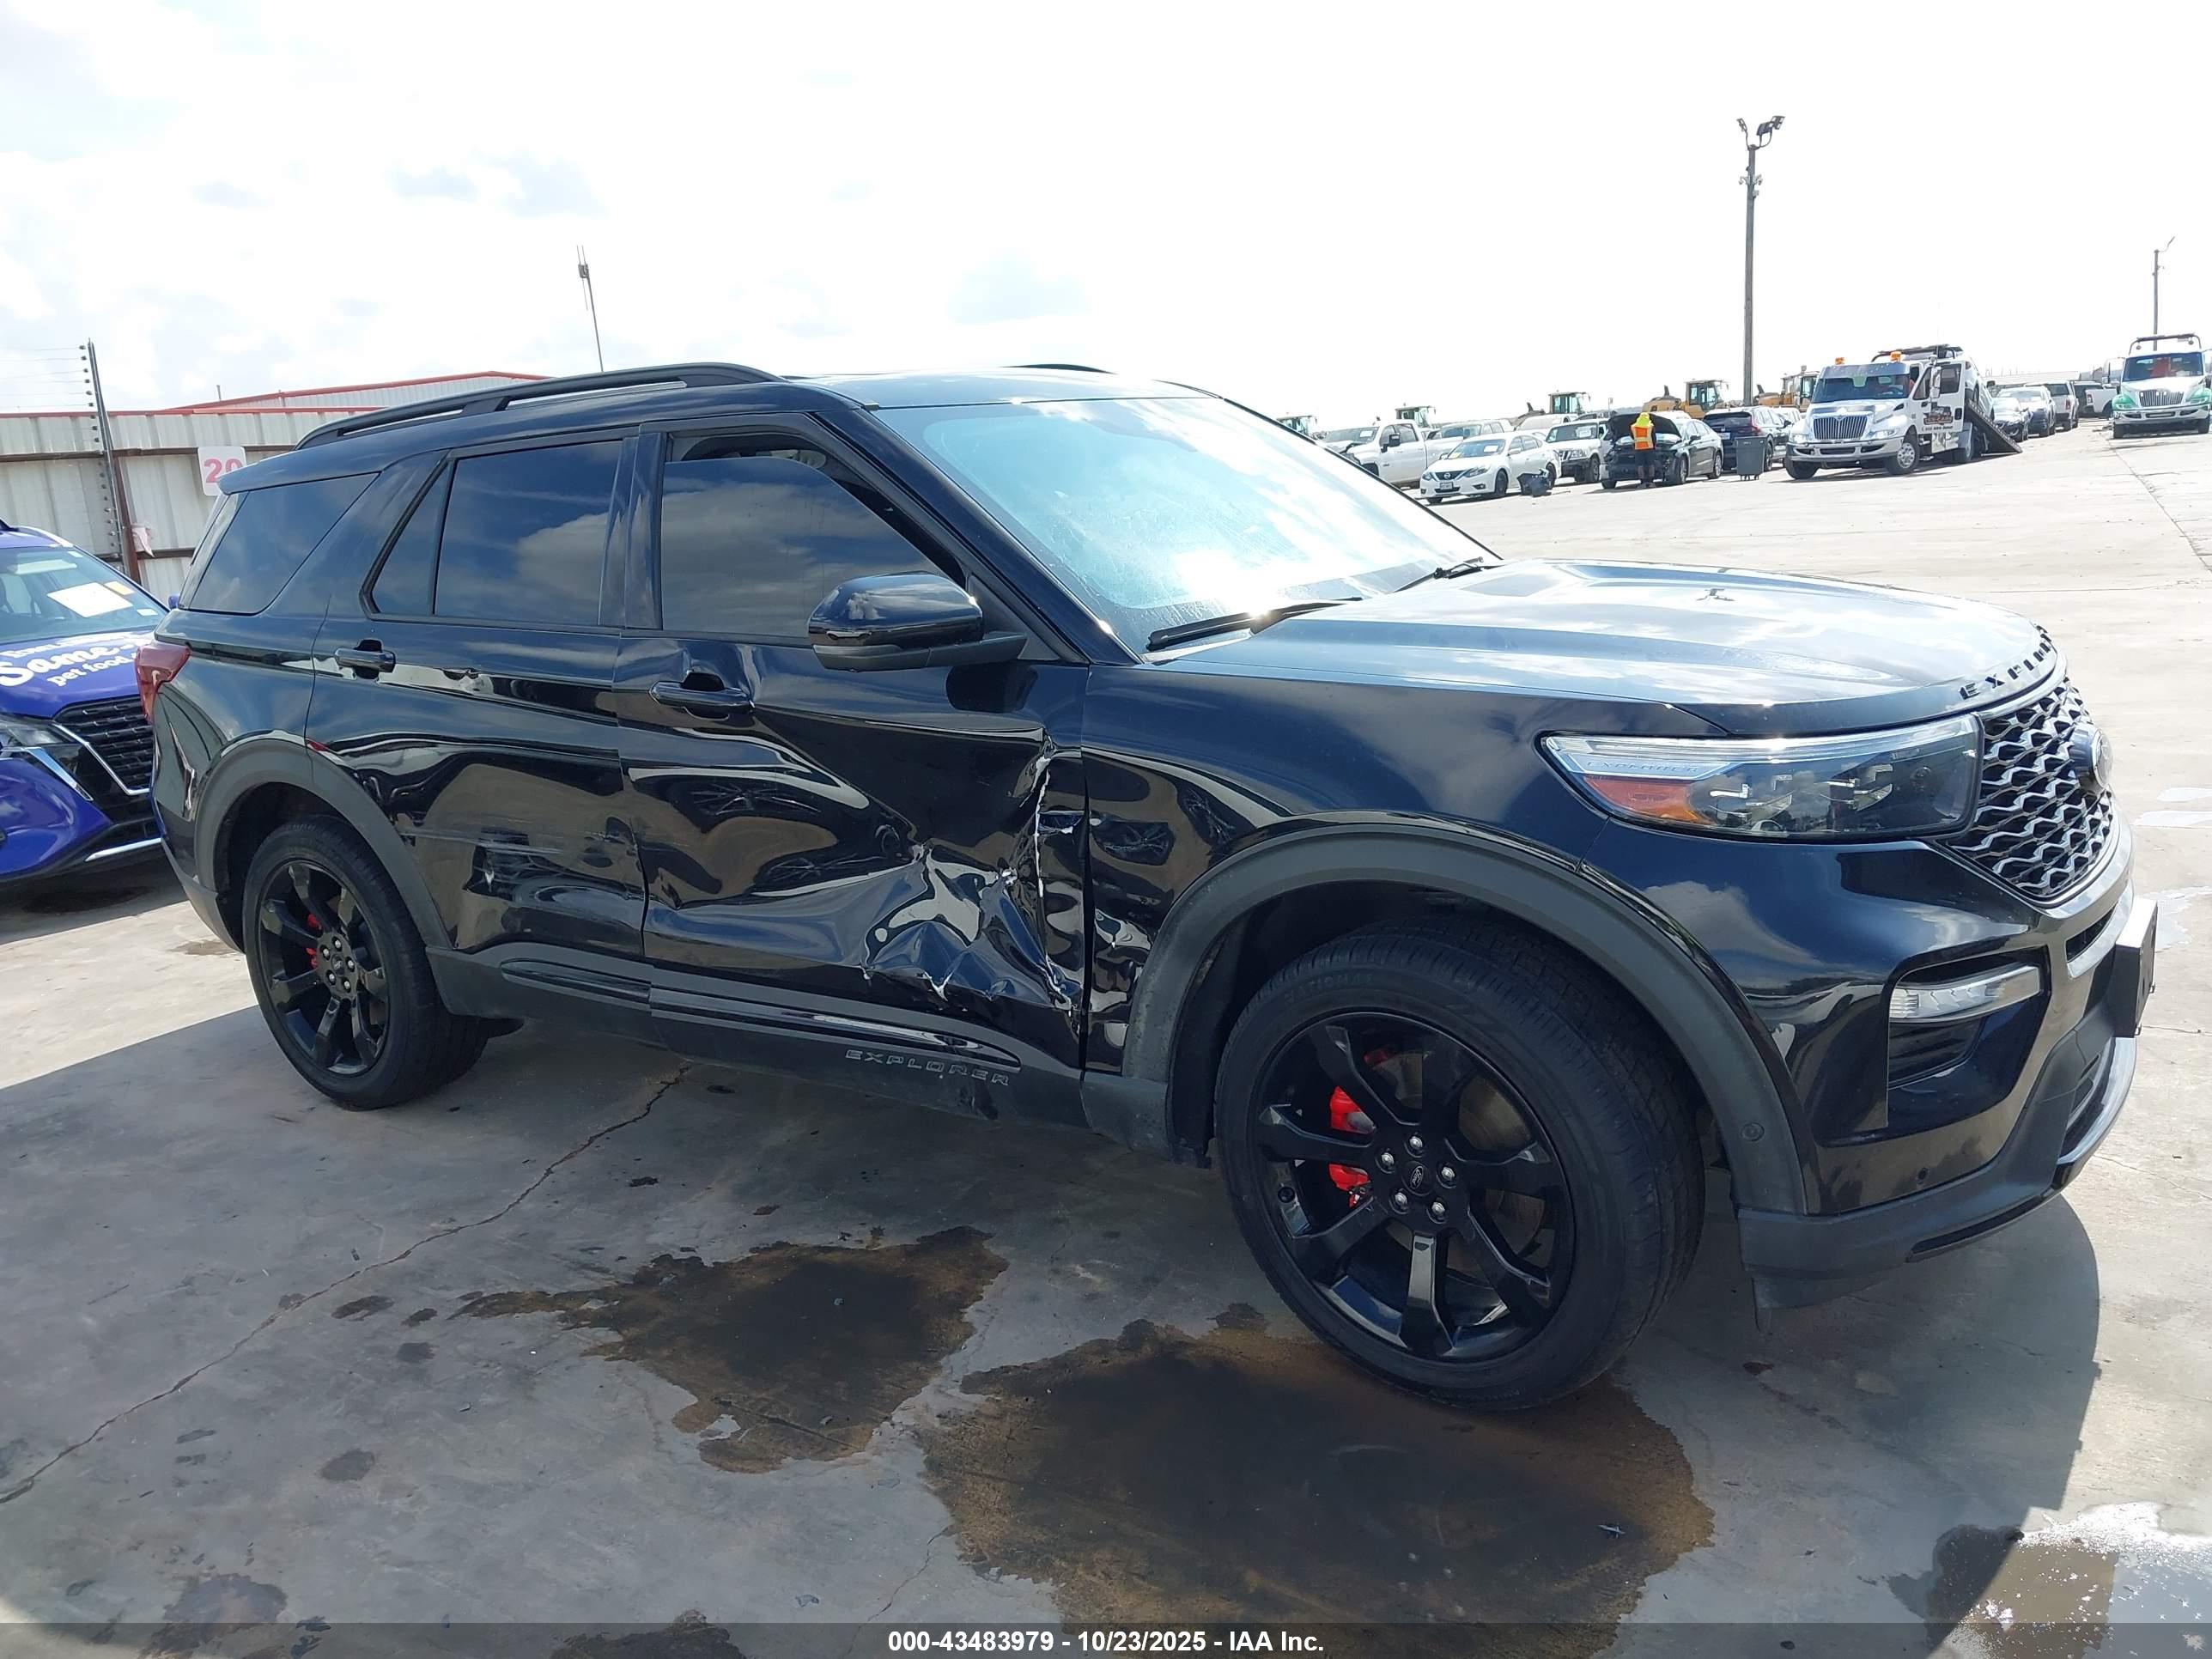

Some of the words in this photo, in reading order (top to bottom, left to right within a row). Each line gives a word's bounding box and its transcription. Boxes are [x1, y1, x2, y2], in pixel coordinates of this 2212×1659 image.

[47, 668, 87, 686] pet
[82, 655, 134, 672] food
[1587, 760, 1699, 773] EXPLORER
[845, 1048, 1009, 1086] EXPLORER
